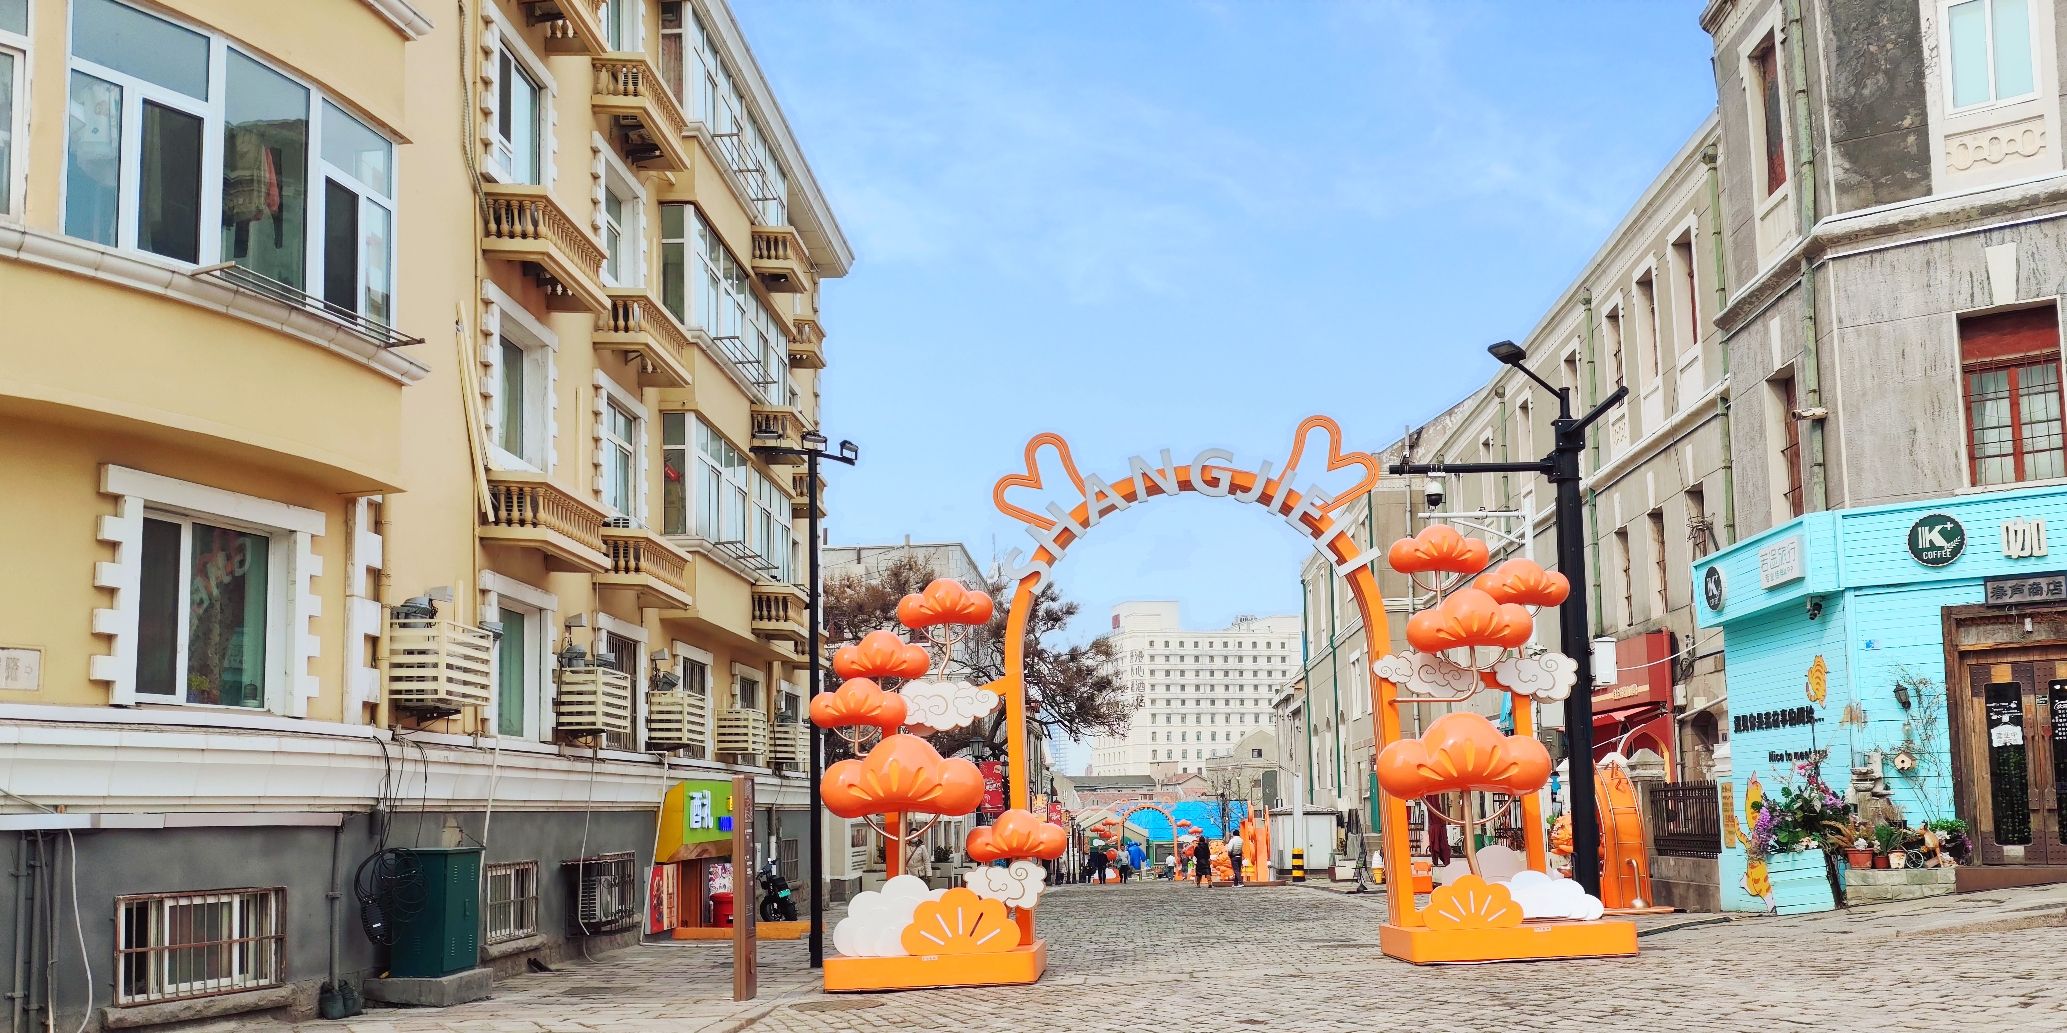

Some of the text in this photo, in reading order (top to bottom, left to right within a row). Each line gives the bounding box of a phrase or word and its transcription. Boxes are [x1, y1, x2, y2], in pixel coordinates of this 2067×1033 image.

[2000, 516, 2048, 559] 咖
[1922, 549, 1952, 560] COFFEE
[1768, 750, 1785, 763] Nice
